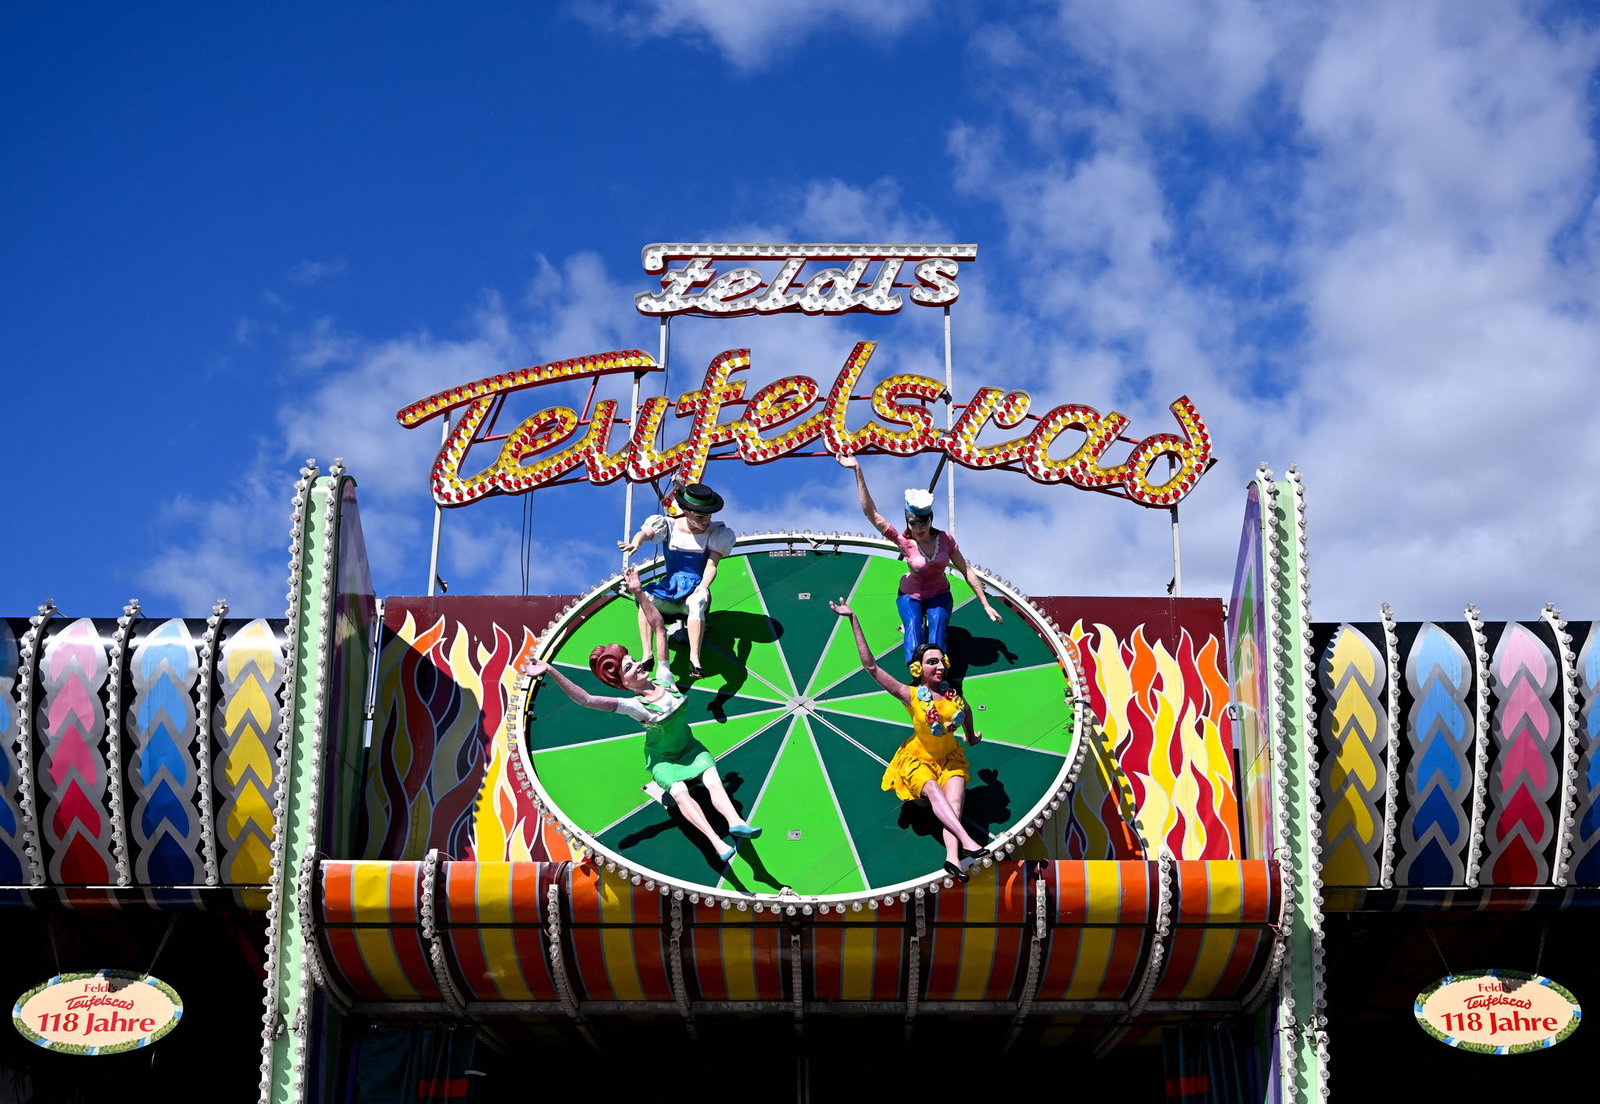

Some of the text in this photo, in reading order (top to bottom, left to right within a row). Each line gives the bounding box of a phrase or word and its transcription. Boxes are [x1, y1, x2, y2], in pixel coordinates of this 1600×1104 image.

[396, 340, 1218, 516] Teufelsrad
[65, 994, 135, 1011] Teufelsrad
[1463, 993, 1532, 1011] Teufelsrad
[37, 1011, 156, 1036] 118 Jahre
[1440, 1010, 1558, 1036] 118 Jahre
